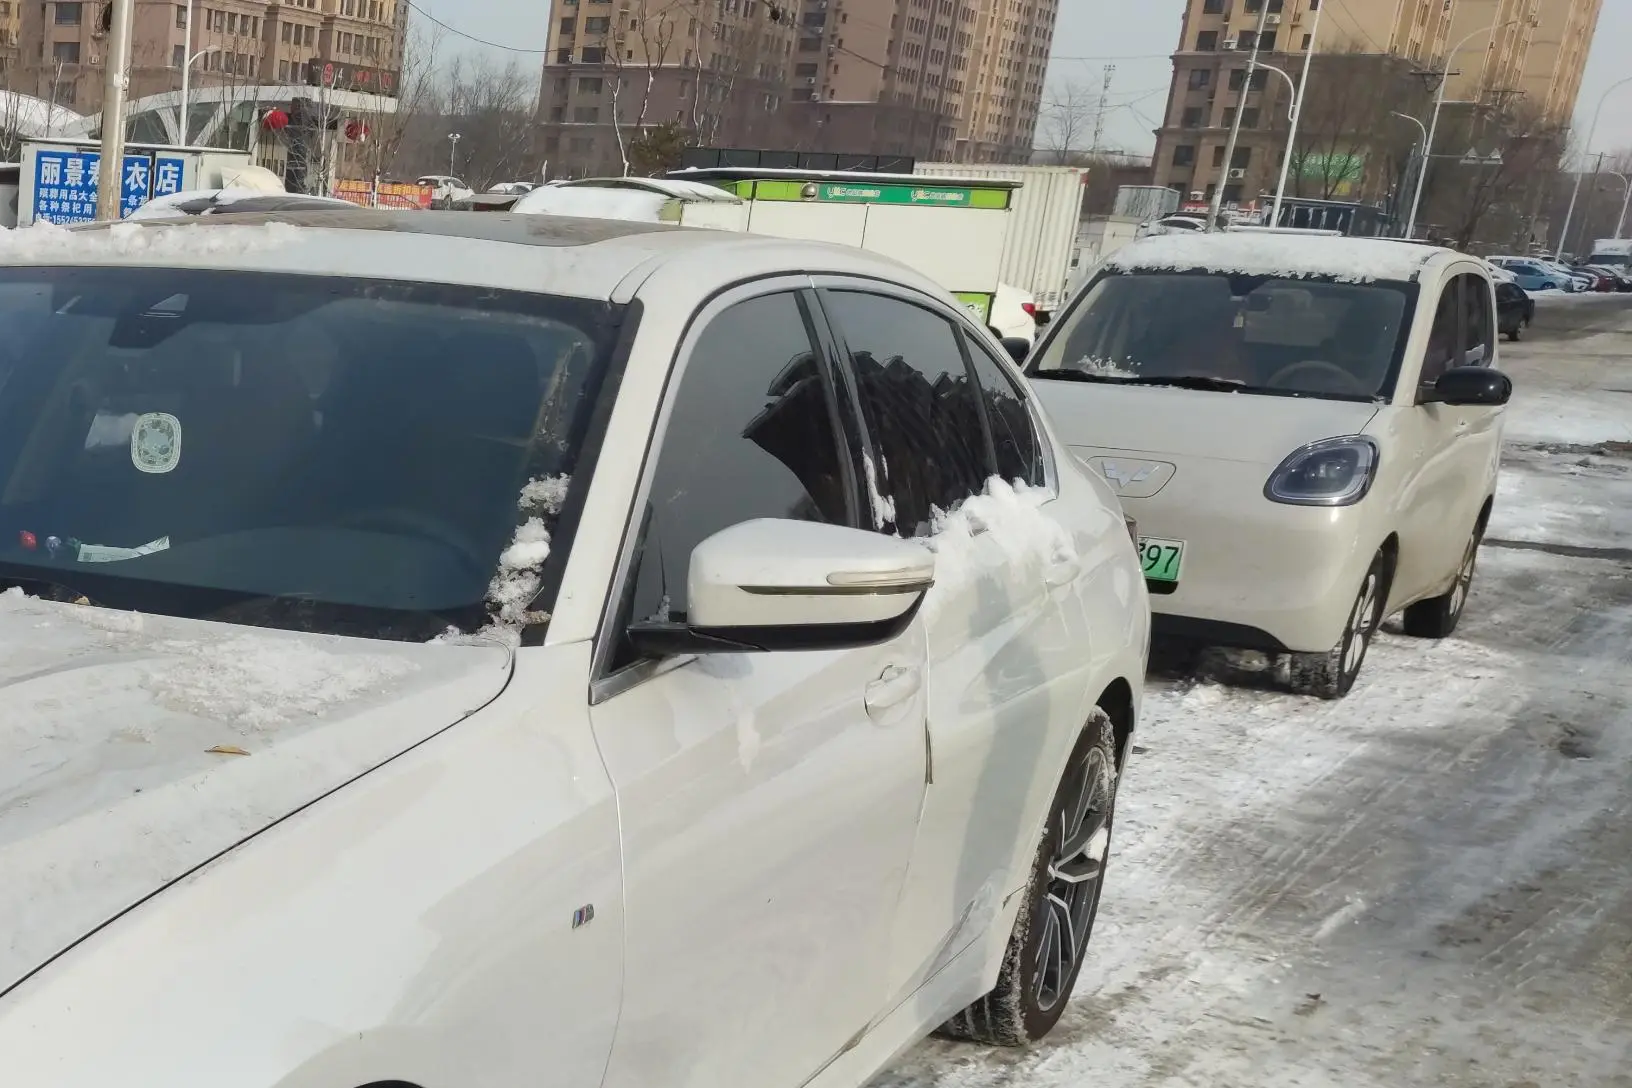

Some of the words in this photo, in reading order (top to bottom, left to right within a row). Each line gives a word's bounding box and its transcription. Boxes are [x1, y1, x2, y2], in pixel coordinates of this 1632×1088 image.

[38, 199, 97, 215] 各种祭祀用
